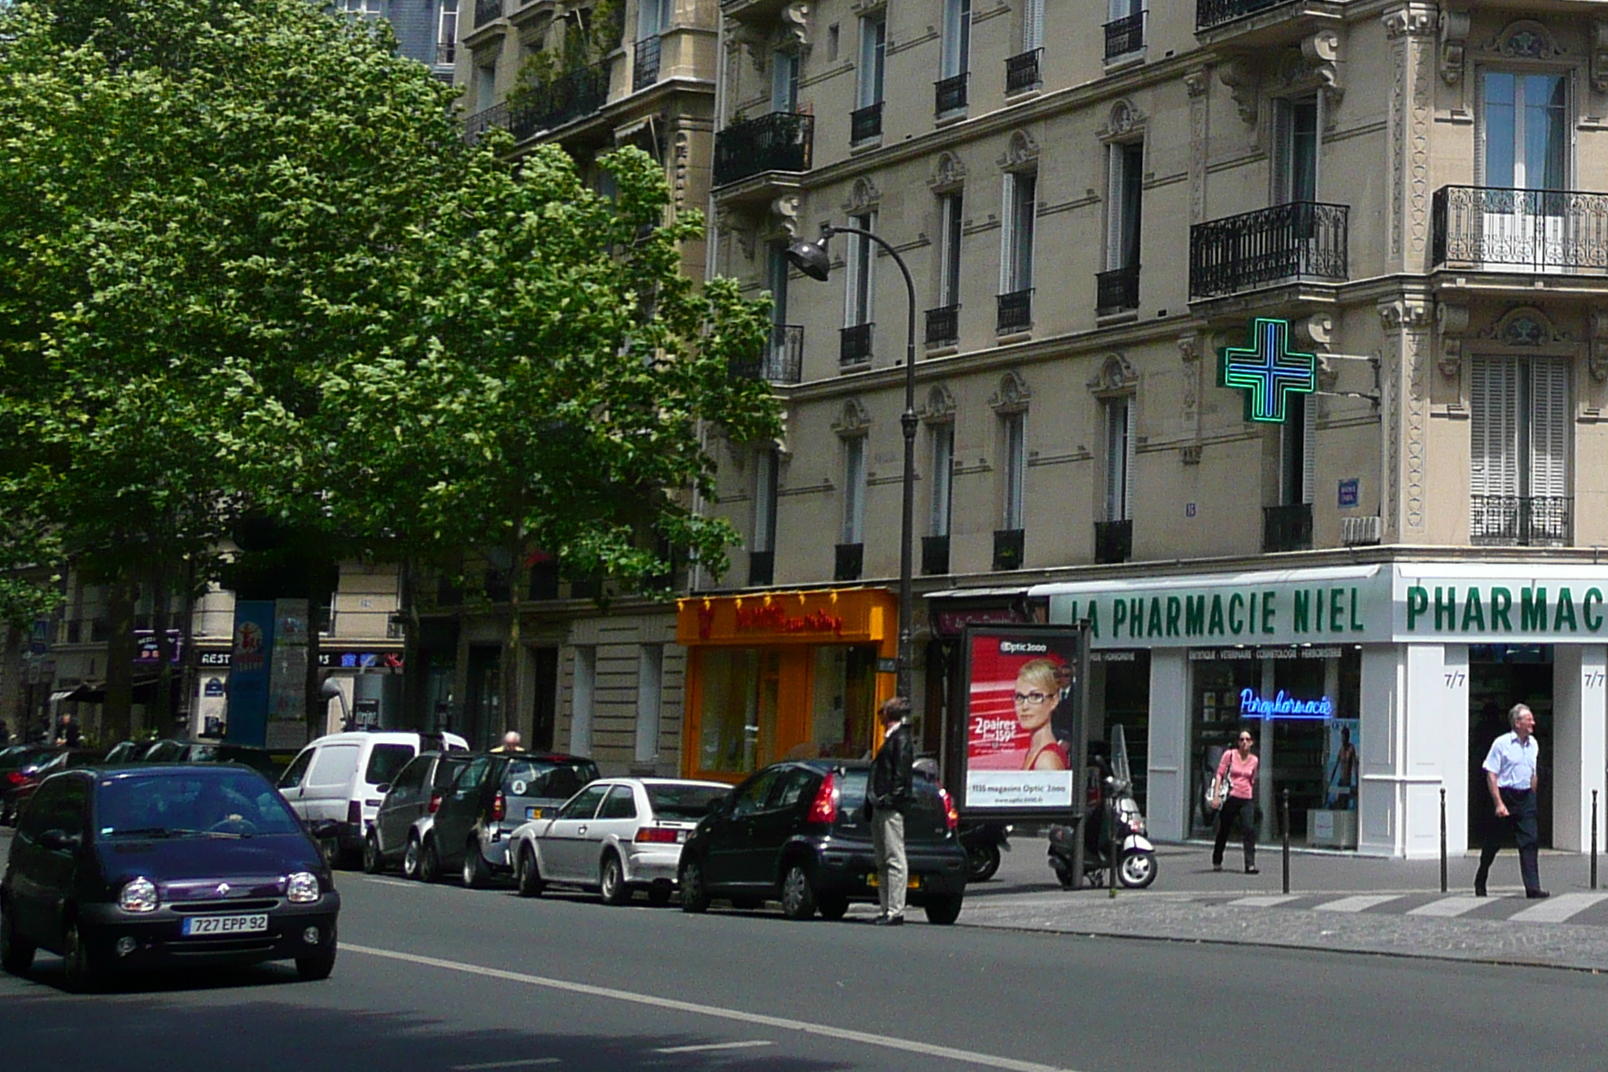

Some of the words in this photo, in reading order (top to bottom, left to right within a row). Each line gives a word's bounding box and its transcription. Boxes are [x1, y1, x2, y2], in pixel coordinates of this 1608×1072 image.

[1072, 600, 1099, 638] LA
[1113, 591, 1276, 637] PHARMACIE
[1294, 587, 1364, 632] NIEL
[1444, 670, 1466, 688] 7/7
[1584, 671, 1604, 688] 7/7
[1240, 688, 1332, 721] Parapharmacie
[195, 919, 220, 932] 727
[222, 918, 246, 931] EPP
[249, 916, 266, 929] 92
